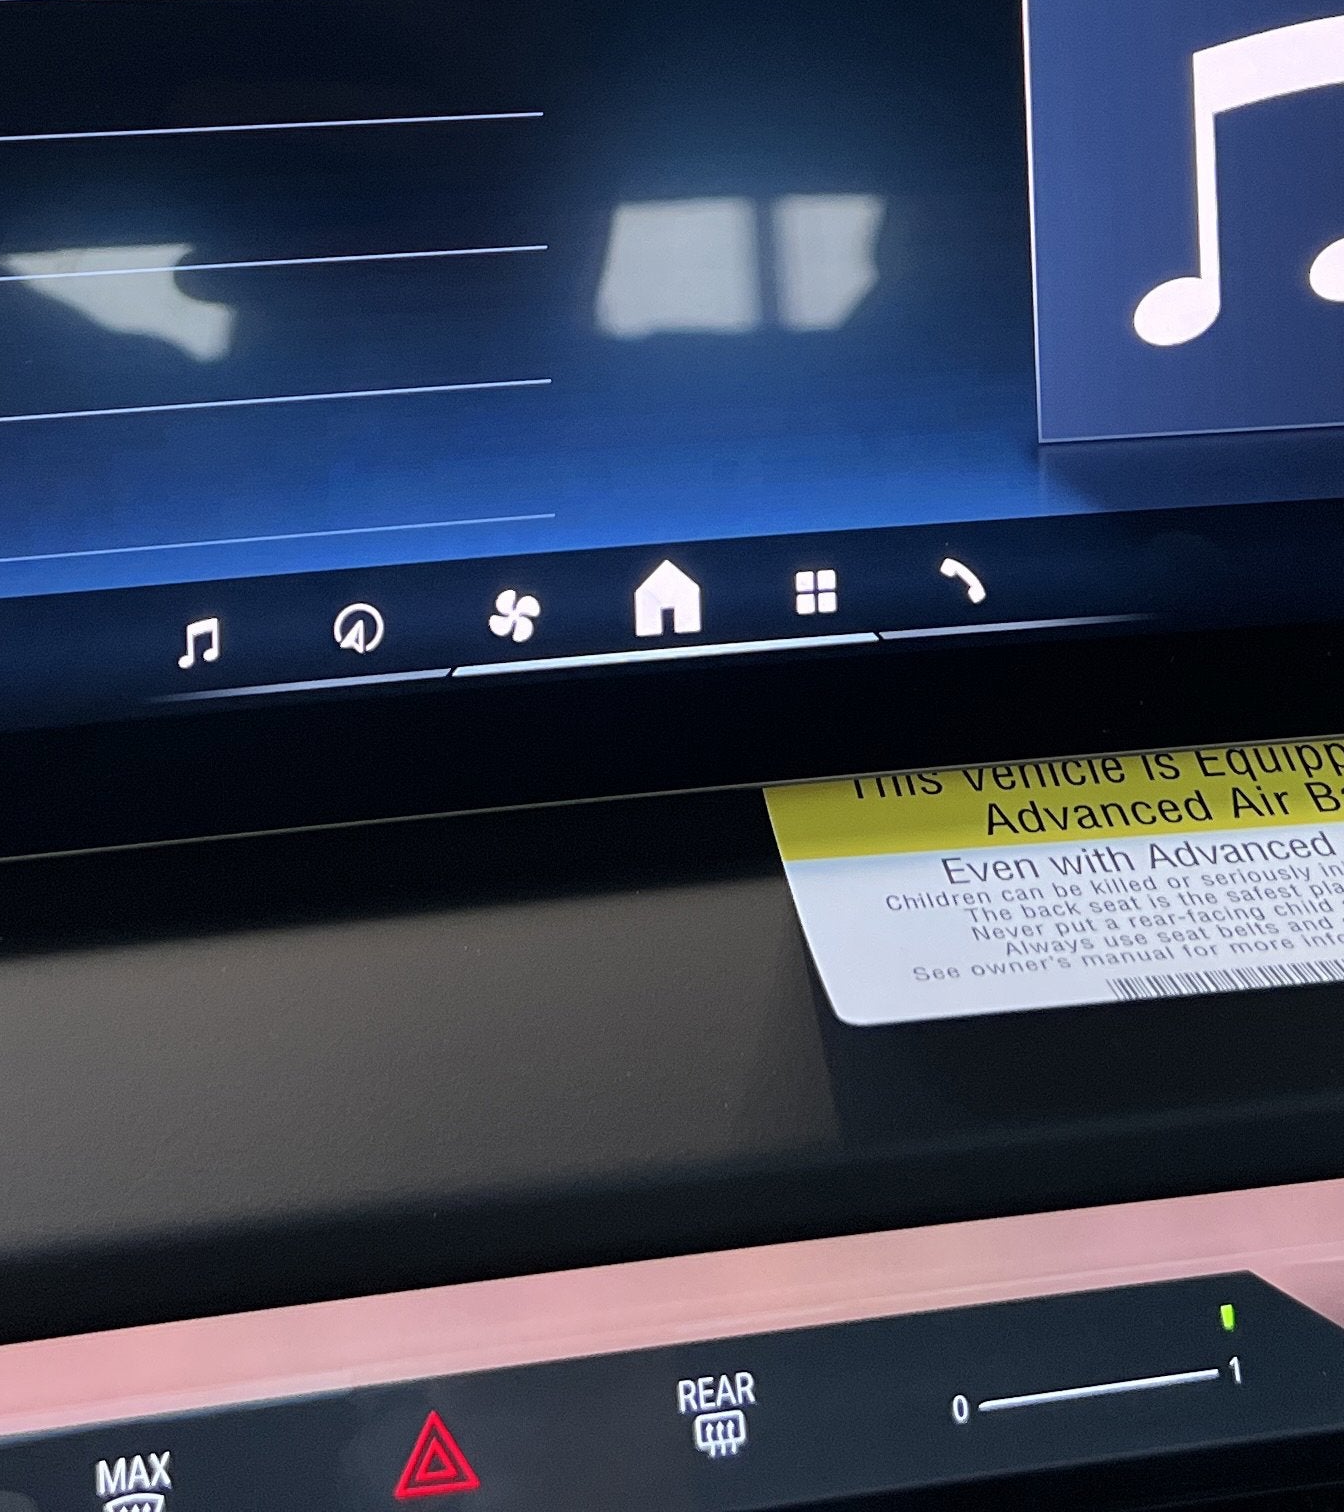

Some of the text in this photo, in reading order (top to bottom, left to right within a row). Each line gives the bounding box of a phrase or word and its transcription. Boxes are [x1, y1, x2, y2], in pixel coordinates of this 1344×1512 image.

[987, 790, 1213, 835] Advanced
[1231, 785, 1289, 819] Air
[941, 857, 1040, 884] Even
[1048, 846, 1135, 876] with
[1149, 831, 1337, 869] Advanced
[886, 892, 991, 911] Children
[1002, 887, 1044, 902] can
[1052, 881, 1082, 898] be
[1090, 876, 1157, 896] killed
[1167, 876, 1190, 889] or
[1201, 864, 1311, 887] seriously
[963, 906, 1012, 924] The
[1022, 900, 1081, 919] back
[1089, 896, 1142, 915] seat
[1150, 893, 1171, 909] is
[1178, 890, 1218, 907] the
[1226, 883, 1303, 903] safest
[971, 924, 1043, 942] Never
[1054, 919, 1098, 938] put
[1105, 918, 1120, 931] a
[1129, 904, 1266, 929] rear-facing
[1274, 897, 1334, 918] child
[1006, 936, 1094, 957] Always
[1104, 932, 1148, 948] use
[1157, 925, 1211, 946] seat
[1215, 919, 1280, 939] belts
[1287, 913, 1333, 934] and
[913, 965, 960, 982] See
[970, 954, 1072, 977] owner's
[1081, 944, 1175, 968] manual
[1182, 941, 1218, 959] for
[1229, 935, 1295, 956] more
[677, 1371, 756, 1414] REAR
[1227, 1356, 1243, 1385] 1
[951, 1393, 969, 1425] 0
[95, 1450, 172, 1500] MAX
